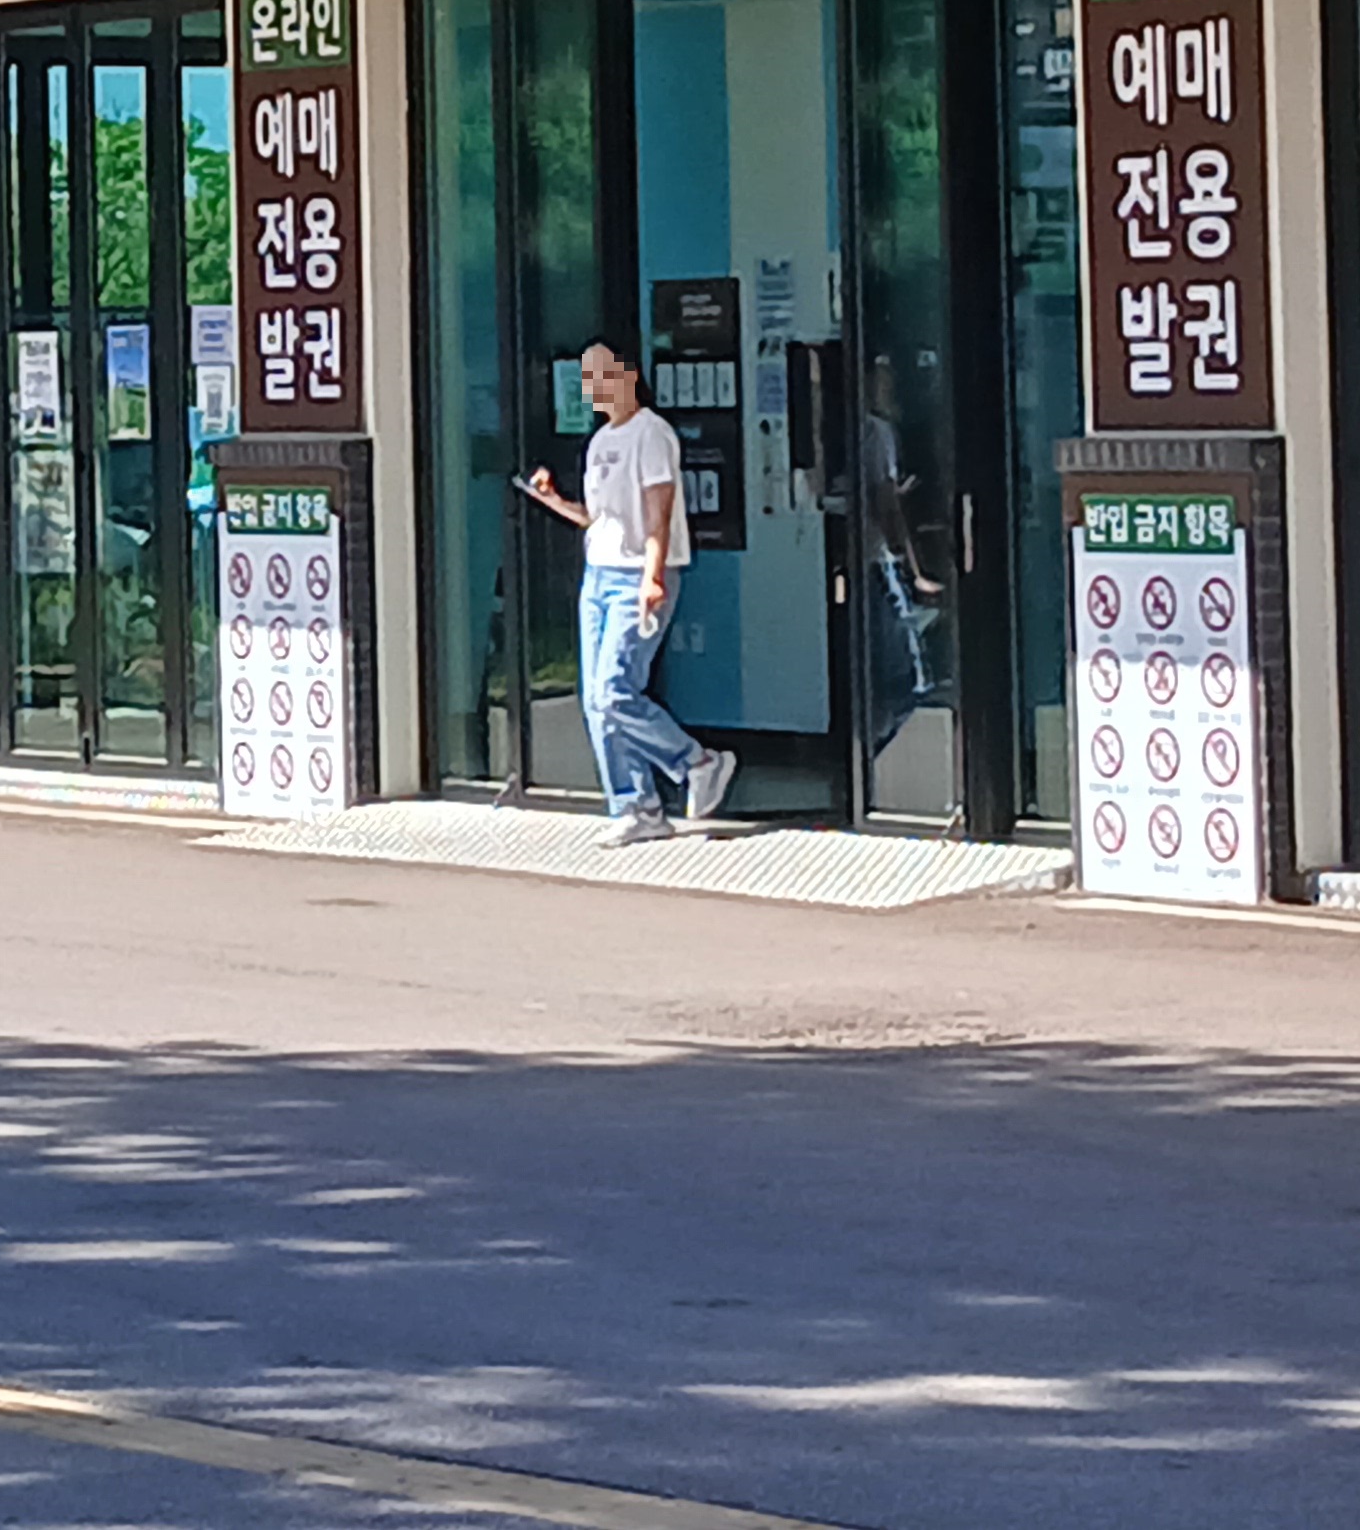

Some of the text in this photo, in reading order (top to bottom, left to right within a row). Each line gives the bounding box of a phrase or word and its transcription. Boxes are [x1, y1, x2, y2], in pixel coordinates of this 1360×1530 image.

[1112, 17, 1231, 126] 예매
[255, 88, 338, 181] 예매
[257, 196, 341, 289] 전용
[1117, 148, 1238, 259] 전용
[259, 306, 342, 401] 발권
[1121, 280, 1240, 392] 발권
[1084, 502, 1230, 548] 반입 금지 항목
